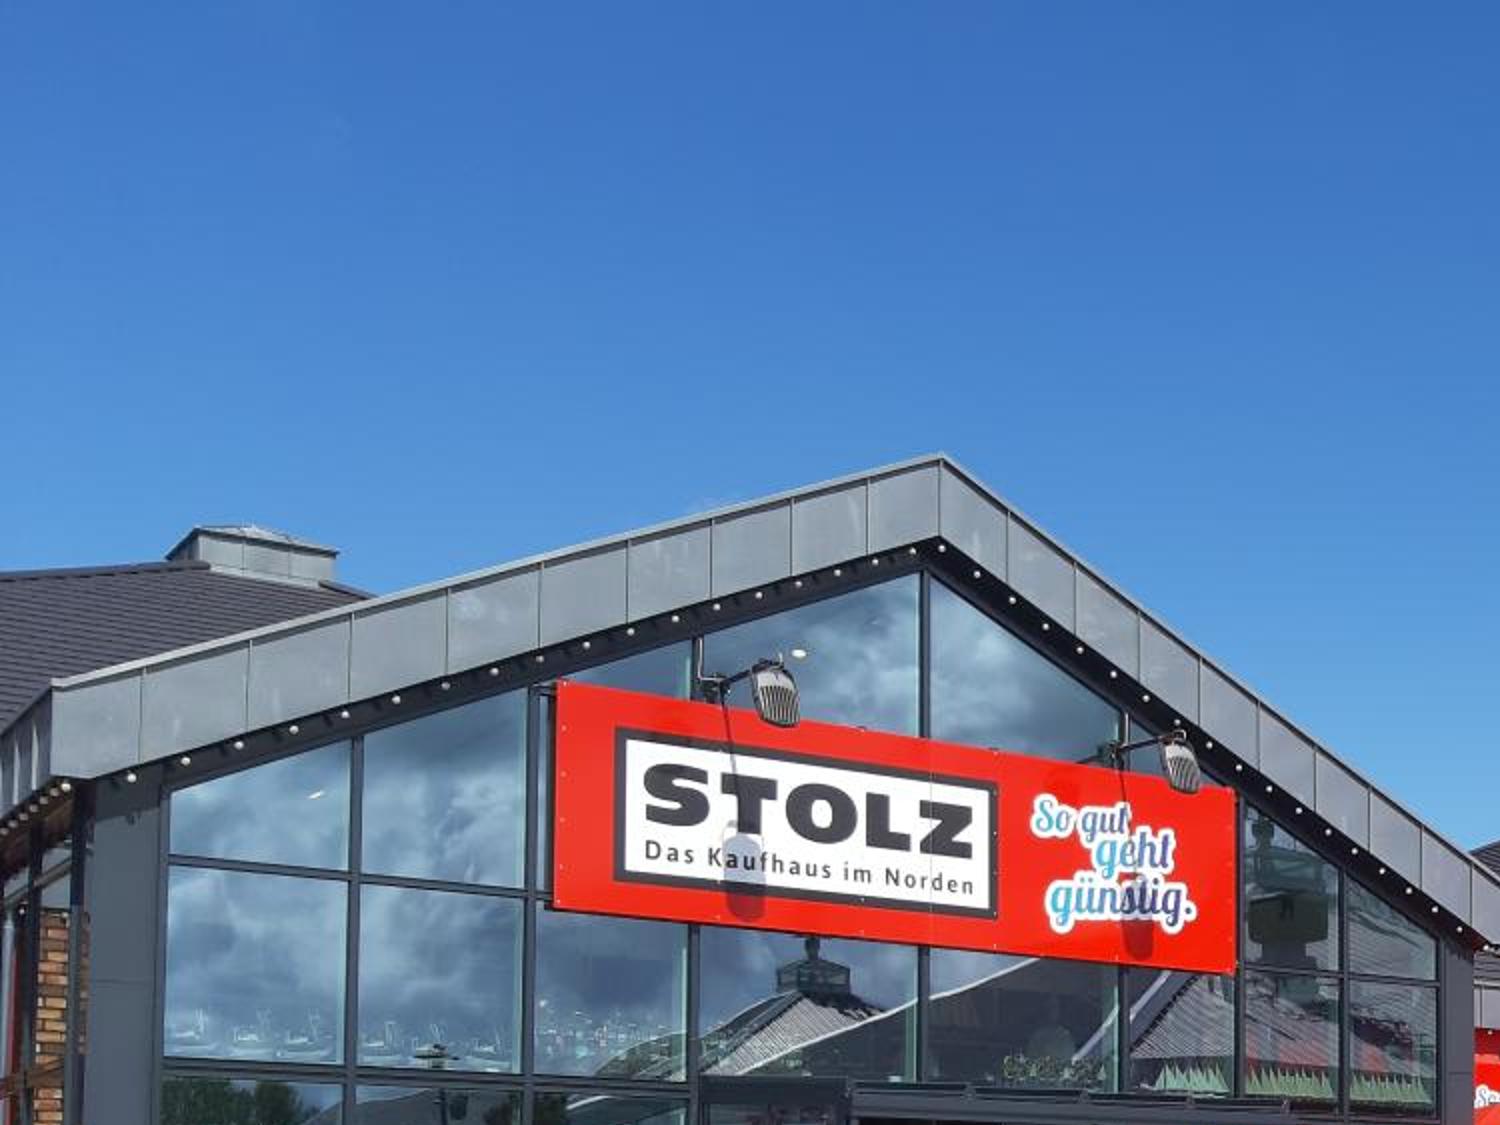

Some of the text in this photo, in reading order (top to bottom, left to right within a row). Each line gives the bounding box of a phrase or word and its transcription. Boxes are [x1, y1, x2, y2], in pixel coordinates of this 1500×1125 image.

[643, 763, 973, 859] STOLZ
[1033, 798, 1131, 843] So gut
[645, 840, 974, 895] Das Kaufhaus im Norden
[1094, 831, 1171, 880] geht
[1049, 876, 1192, 928] günstig.
